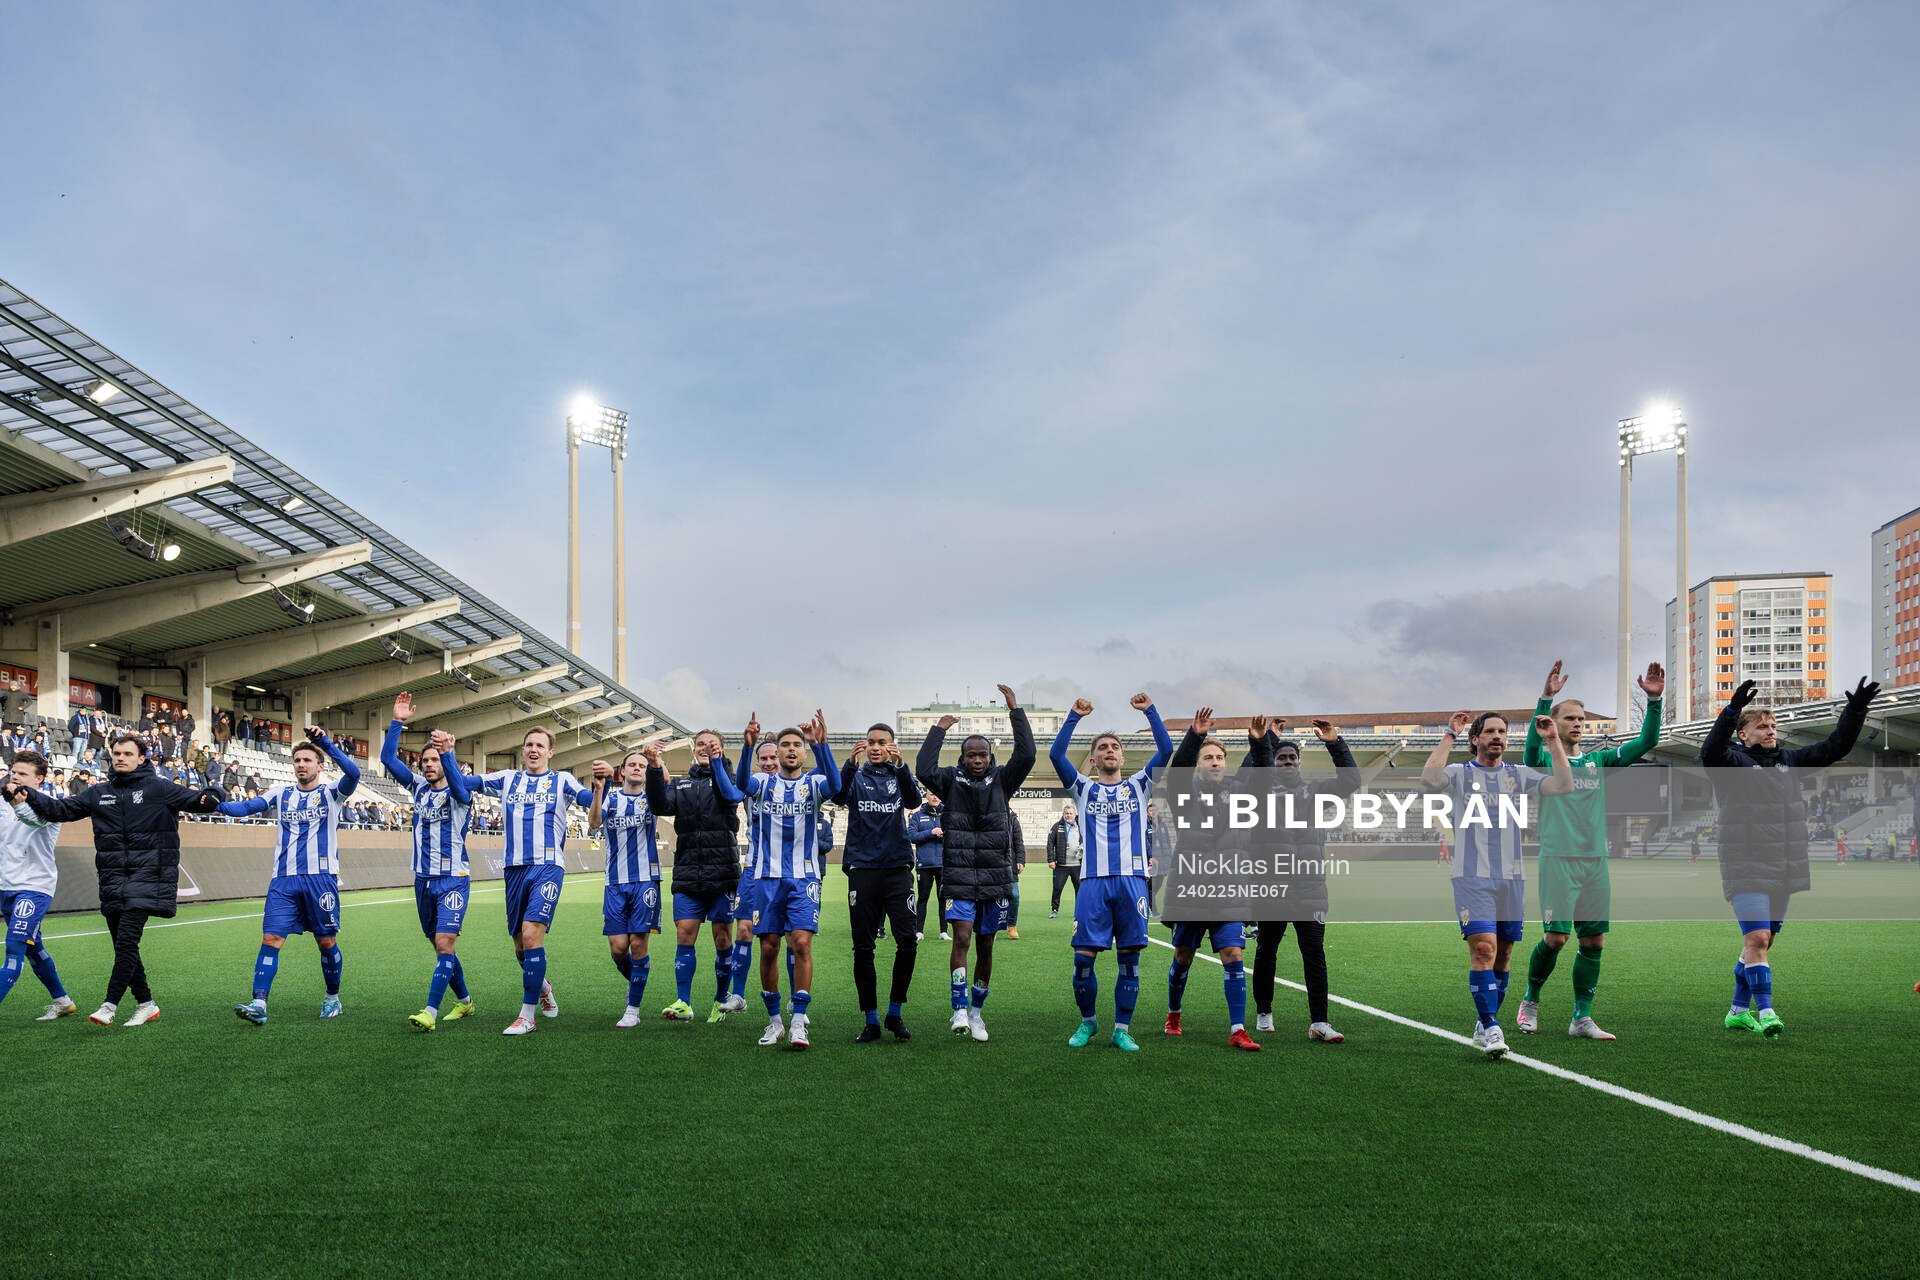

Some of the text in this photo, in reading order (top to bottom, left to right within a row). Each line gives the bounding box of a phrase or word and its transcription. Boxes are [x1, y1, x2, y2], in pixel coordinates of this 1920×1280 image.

[507, 792, 555, 803] SERNEKE
[1019, 788, 1052, 798] bravida
[763, 801, 812, 815] SERNEKE
[858, 797, 902, 813] SERNEKE
[1088, 799, 1138, 814] SERNEKE
[281, 806, 327, 821] SERNEKE
[320, 893, 334, 910] MG
[446, 892, 462, 909] MG
[15, 900, 34, 917] MG
[454, 912, 460, 922] 2
[14, 920, 28, 930] 23
